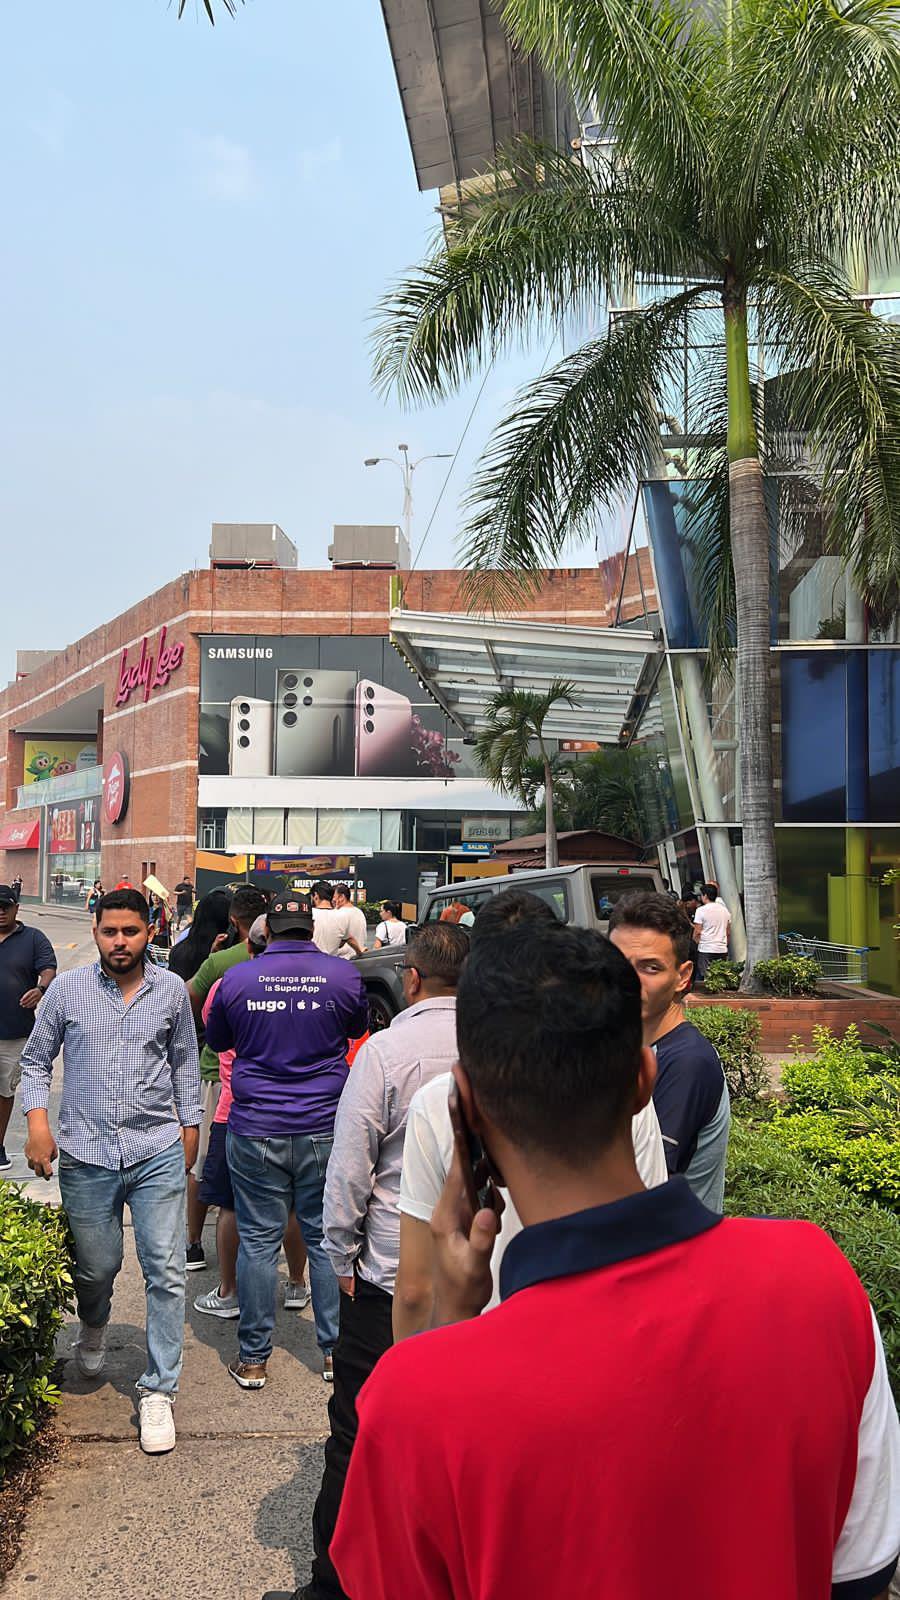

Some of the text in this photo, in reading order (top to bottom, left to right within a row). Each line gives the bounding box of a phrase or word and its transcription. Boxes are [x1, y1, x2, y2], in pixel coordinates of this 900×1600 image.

[208, 647, 273, 659] SAMSUNG
[294, 879, 320, 888] NUEV
[258, 975, 327, 984] Descarga gratis
[265, 984, 320, 994] la SuperApp
[246, 999, 287, 1012] hugo
